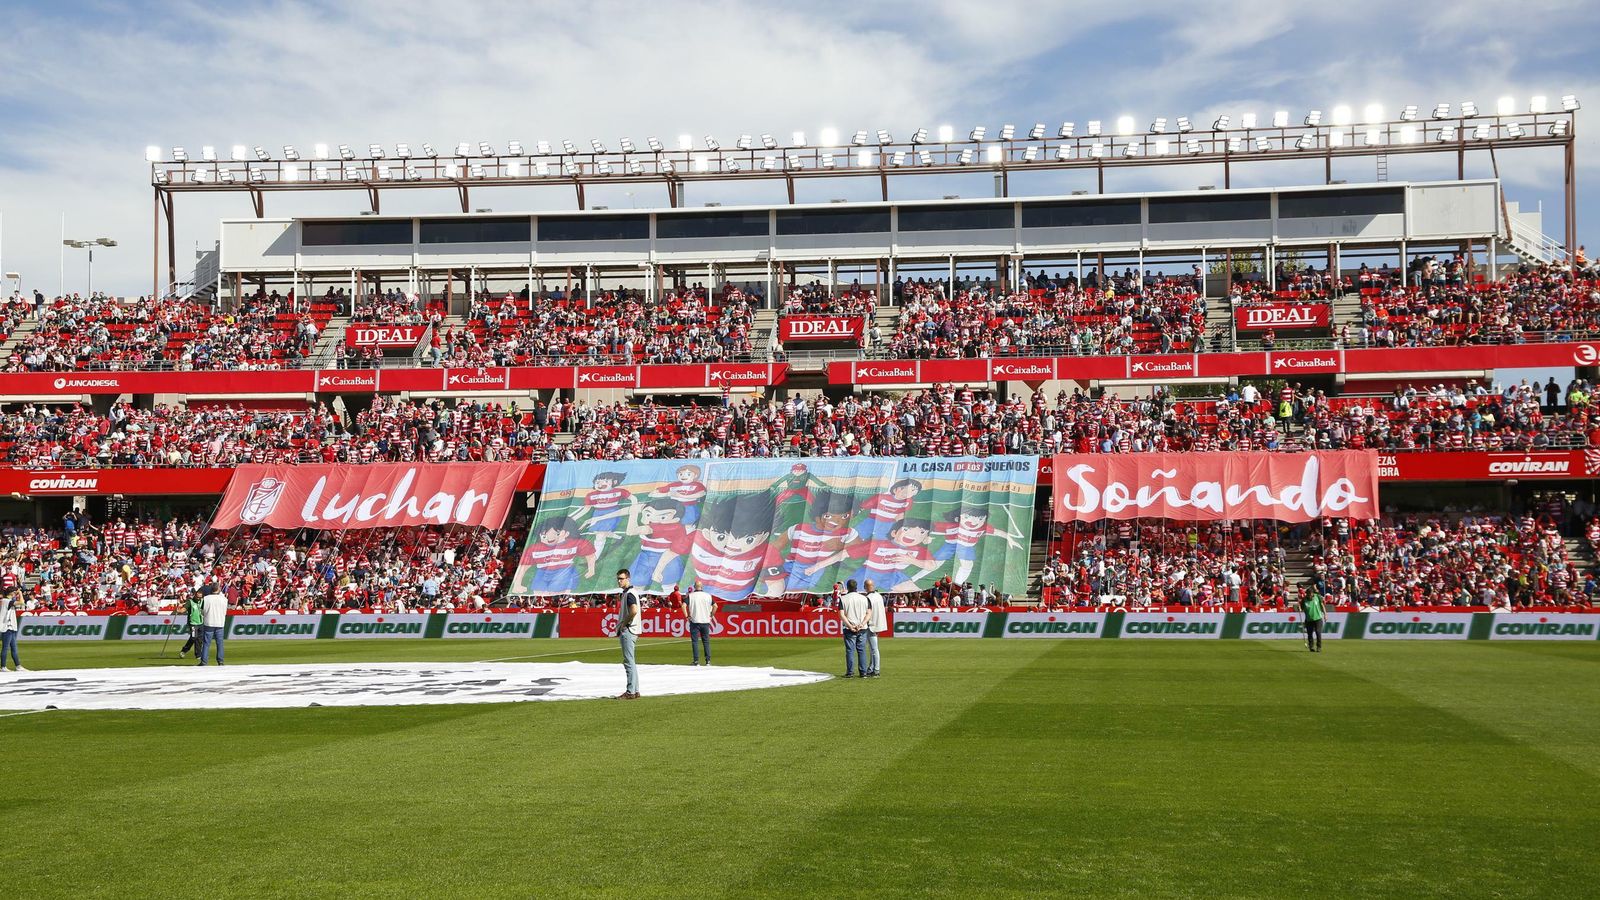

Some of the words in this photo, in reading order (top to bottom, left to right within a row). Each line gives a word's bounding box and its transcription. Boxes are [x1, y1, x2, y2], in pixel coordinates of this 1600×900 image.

[1246, 307, 1317, 324] IDEAL
[355, 328, 417, 343] IDEAL
[789, 320, 854, 335] IDEAL
[1005, 365, 1052, 375] CaixaBank
[1145, 361, 1193, 371] CaixaBank
[1287, 357, 1337, 368] CaixaBank
[461, 374, 504, 384] CaixaBank
[591, 372, 635, 382] CaixaBank
[722, 370, 767, 380] CaixaBank
[869, 367, 915, 377] CaixaBank
[65, 379, 120, 387] JUNCADIESEL
[331, 376, 375, 386] CaixaBank
[902, 462, 917, 473] LA
[920, 461, 953, 473] CASA
[984, 460, 1031, 473] SUEÑOS
[1063, 454, 1369, 518] Soñando
[21, 619, 103, 637] COVIRAN
[126, 618, 190, 636] COVIRA
[232, 618, 316, 636] COVIRAN
[339, 617, 423, 635] COVIRAN
[447, 616, 531, 634] COVIRAN
[893, 616, 981, 634] COVIRAN
[1007, 616, 1098, 634] COVIRAN
[1125, 616, 1219, 634] COVIRAN
[1369, 616, 1466, 635] COVIRAN
[1495, 617, 1595, 636] COVIRAN
